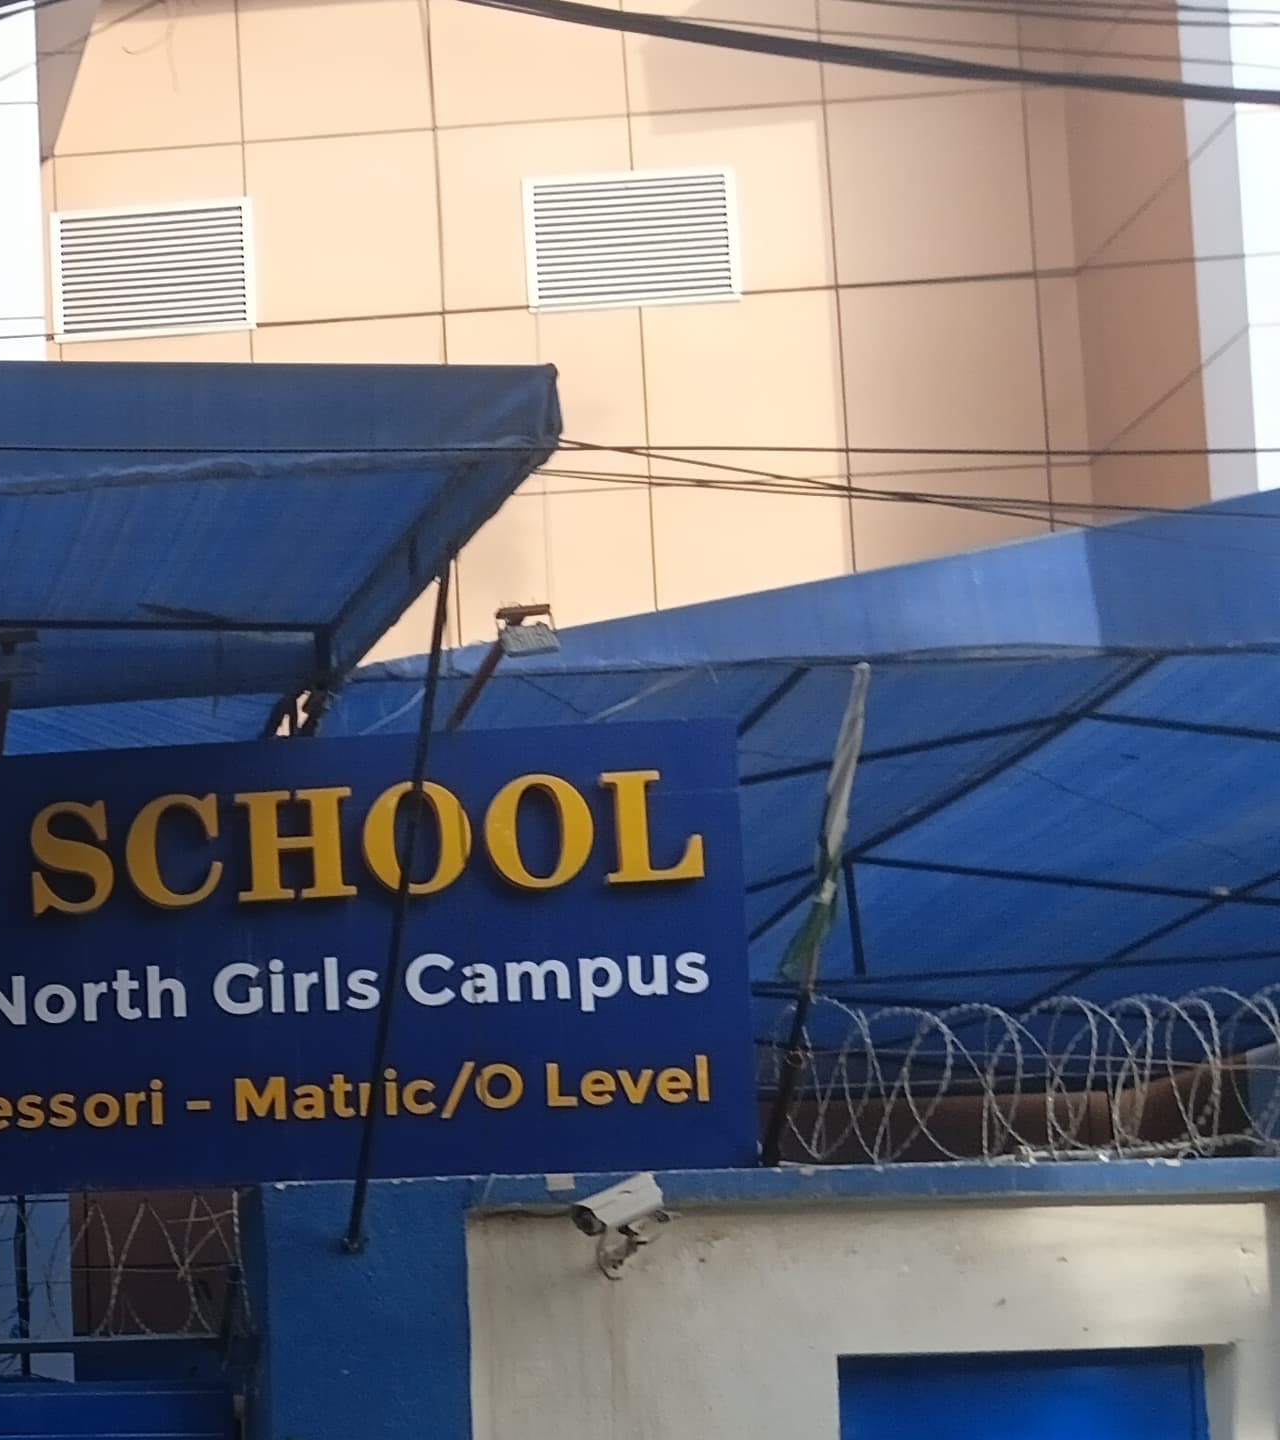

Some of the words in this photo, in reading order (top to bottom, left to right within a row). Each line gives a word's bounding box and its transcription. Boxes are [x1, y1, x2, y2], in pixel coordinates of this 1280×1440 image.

[29, 769, 707, 917] SCHOOL
[212, 956, 381, 1016] Girls
[404, 950, 711, 1012] Campus
[545, 1055, 711, 1108] Level
